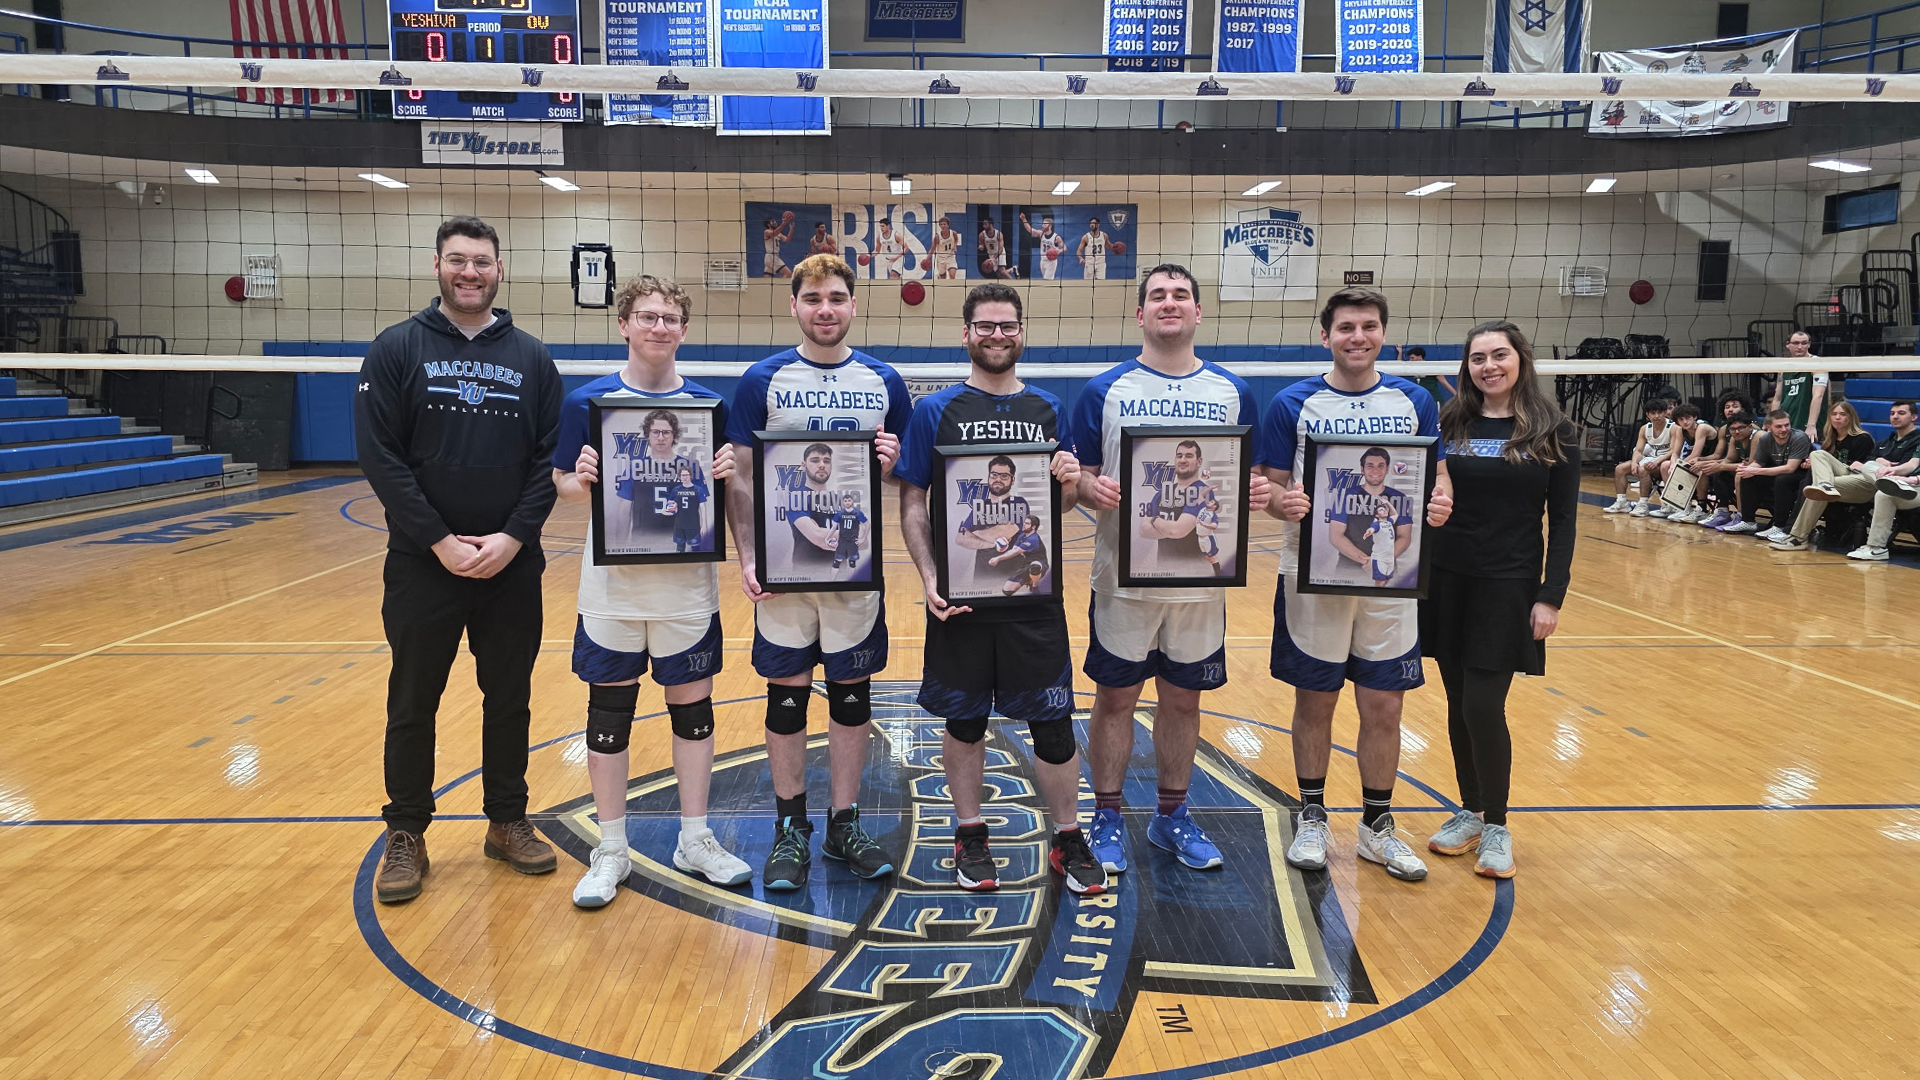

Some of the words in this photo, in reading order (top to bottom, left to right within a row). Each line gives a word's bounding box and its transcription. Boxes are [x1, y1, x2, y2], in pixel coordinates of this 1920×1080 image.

[610, 2, 702, 13] TOURNAMENT
[724, 9, 818, 20] TOURNAMENT
[1113, 8, 1184, 20] CHAMPIONS
[1224, 6, 1294, 18] CHAMPIONS
[1344, 8, 1414, 20] CHAMPIONS
[402, 14, 456, 28] YESHIVA
[468, 22, 500, 32] PERIOD
[1116, 24, 1144, 34] 2014
[1152, 25, 1180, 35] 2015
[1227, 22, 1255, 32] 1987
[1262, 23, 1292, 34] 1999
[1348, 24, 1410, 35] 2017-2018
[426, 32, 444, 62] 0
[486, 38, 492, 58] 1
[554, 34, 572, 64] 0
[1115, 40, 1144, 50] 2016
[1152, 41, 1180, 52] 2017
[1226, 38, 1254, 49] 2017
[1348, 39, 1412, 50] 2019-2020
[1348, 54, 1412, 66] 2021-2022
[240, 62, 264, 82] YU
[520, 67, 544, 88] YU
[796, 72, 819, 92] YU
[1066, 75, 1088, 95] YU
[1334, 75, 1356, 96] YU
[1600, 76, 1623, 96] YU
[1864, 77, 1886, 98] YU
[398, 106, 428, 116] SCORE
[472, 106, 504, 117] MATCH
[548, 108, 578, 118] SCORE
[832, 203, 966, 280] RISE
[1224, 225, 1314, 249] MACCABEES
[1092, 244, 1102, 254] 23
[586, 262, 598, 276] 11
[1251, 268, 1285, 276] UNITE
[1346, 274, 1359, 282] NO
[424, 361, 522, 387] MACCABEES
[458, 380, 488, 404] YU
[775, 391, 884, 411] MACCABEES
[428, 404, 518, 418] ATHLETICS
[1119, 400, 1227, 423] MACCABEES
[958, 420, 1045, 442] YESHIVA
[1305, 416, 1412, 434] MACCABEES
[615, 453, 700, 481] Deutsch
[654, 486, 668, 514] 5
[682, 497, 688, 508] 5
[775, 507, 786, 521] 10
[973, 496, 1026, 525] Rubin
[844, 519, 852, 530] 10
[688, 650, 712, 672] YU
[852, 650, 874, 669] YU
[1204, 662, 1223, 683] YU
[1402, 659, 1422, 680] YU
[1046, 688, 1069, 709] YU
[1156, 1004, 1194, 1034] TM
